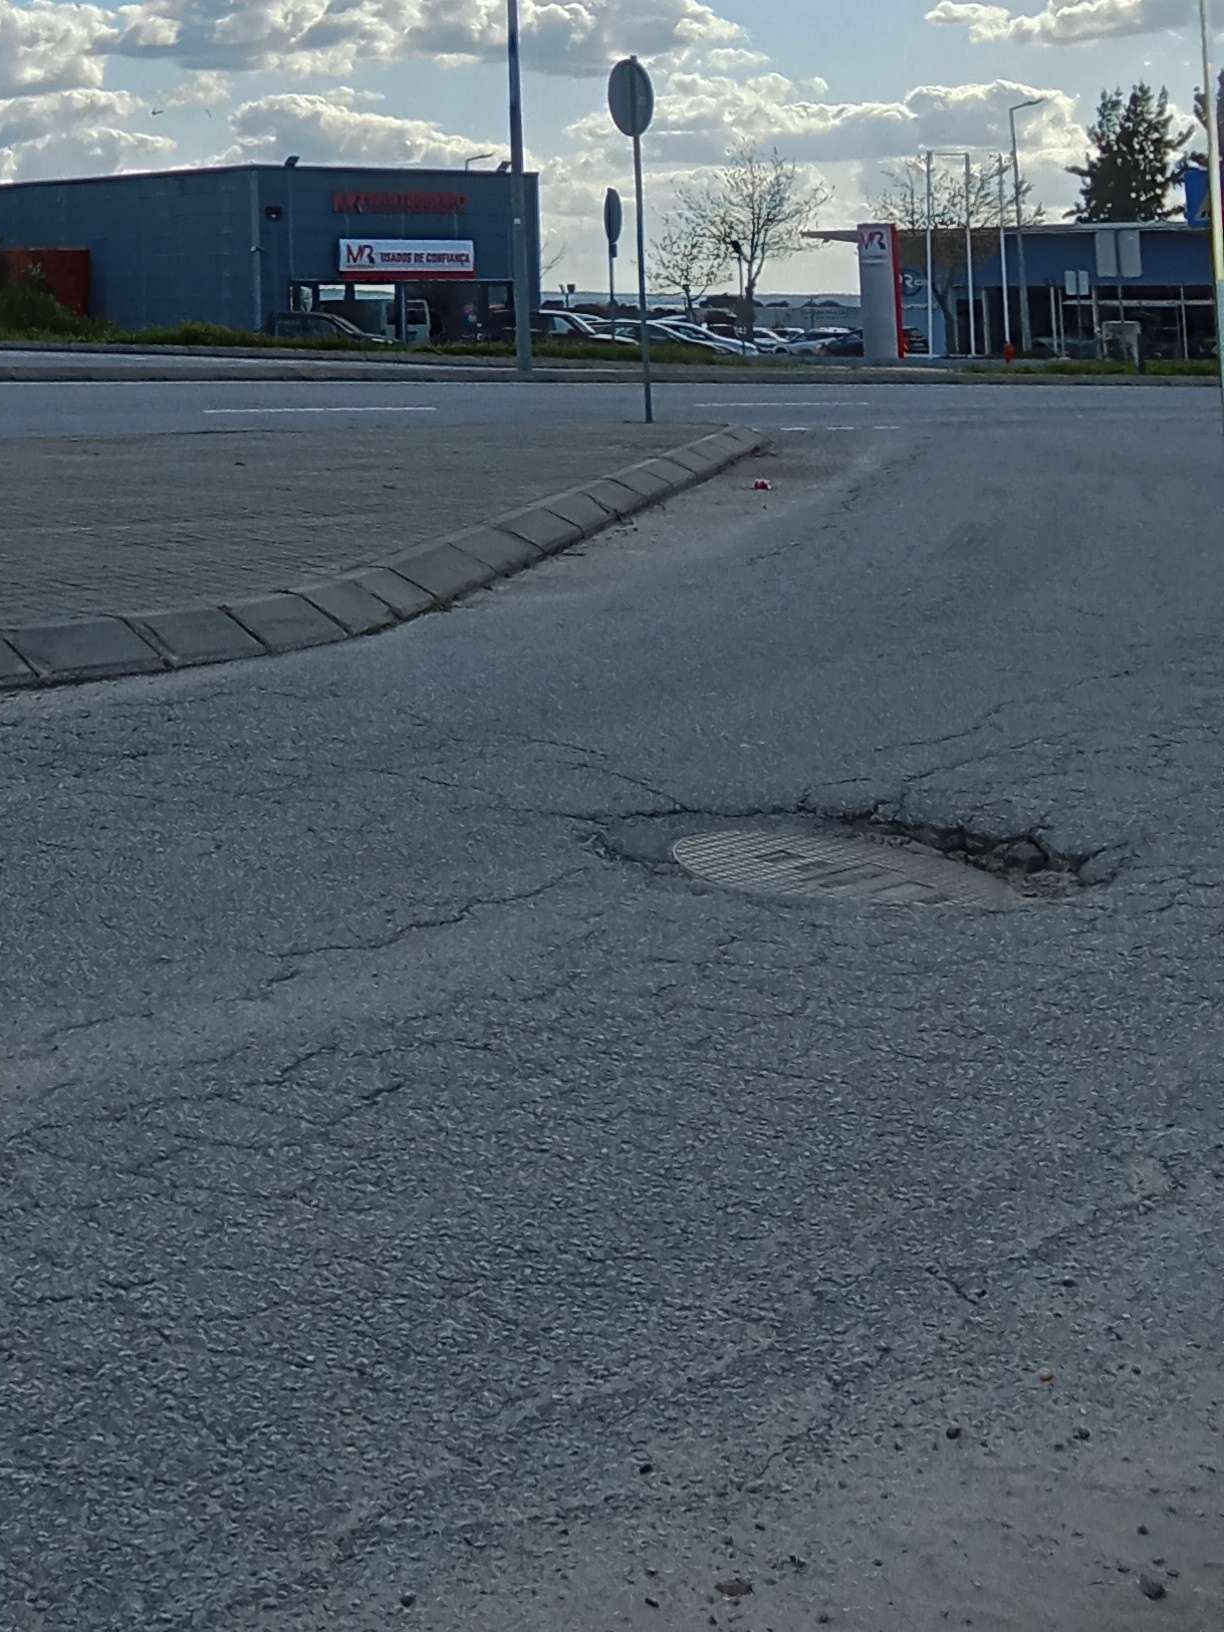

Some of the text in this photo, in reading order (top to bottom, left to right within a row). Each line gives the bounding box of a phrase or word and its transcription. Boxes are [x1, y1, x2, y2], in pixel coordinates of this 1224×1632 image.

[346, 244, 375, 264] MR
[380, 252, 470, 266] USADOS DE CONFIANÇA
